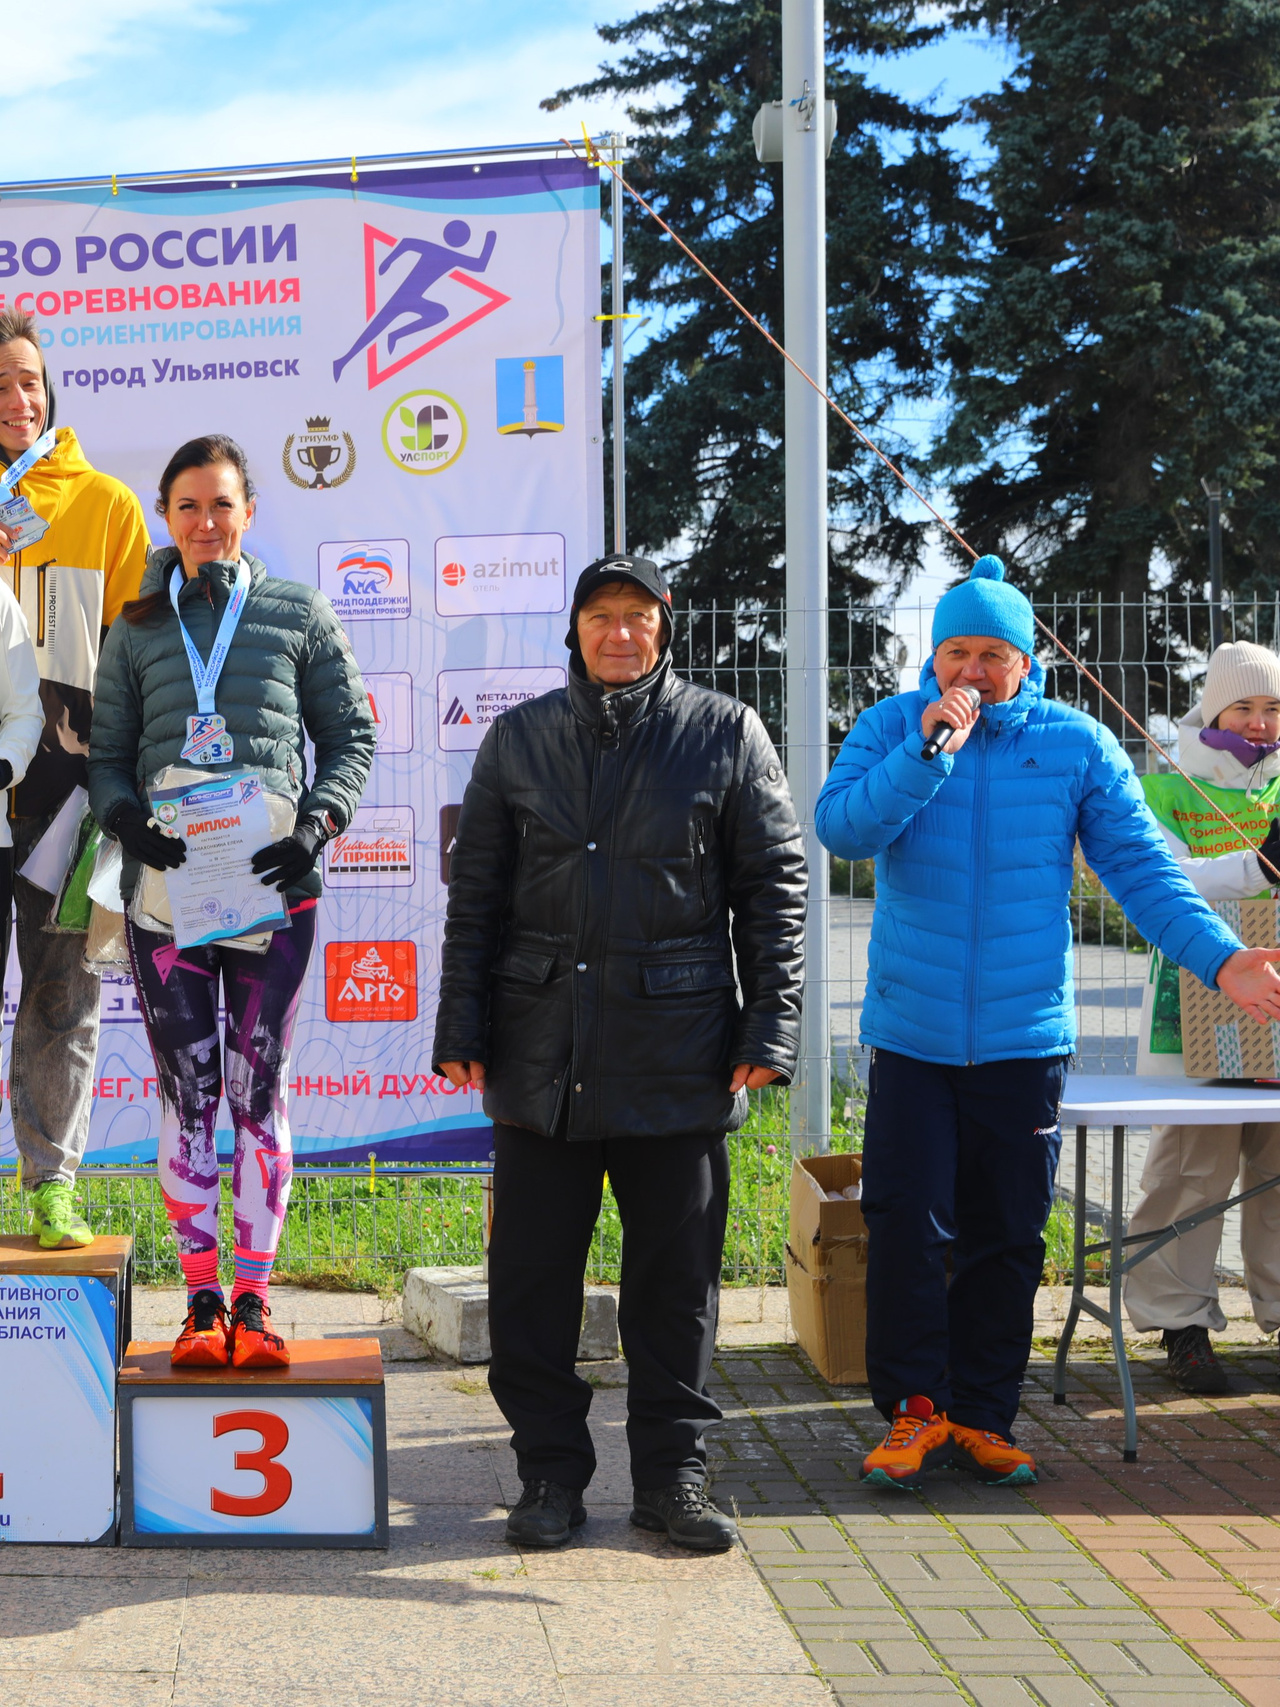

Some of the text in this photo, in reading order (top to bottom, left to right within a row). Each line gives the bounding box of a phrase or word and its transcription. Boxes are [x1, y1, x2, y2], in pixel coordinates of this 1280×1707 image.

[75, 224, 297, 274] РОССИИ
[14, 278, 300, 316] СОРЕВНОВАНИЯ
[61, 316, 302, 347] ОРИЕНТИРОВАНИЯ
[63, 367, 146, 393] город
[152, 358, 300, 383] Ульяновск
[298, 434, 339, 444] ТРИУМФ
[400, 451, 449, 462] УЛСПОРТ
[473, 557, 559, 578] azimut
[331, 596, 408, 607] ОНД ПОДДЕРЖКИ
[205, 642, 222, 687] ВСЕРОССИЙСКИЕ
[210, 646, 226, 688] СОРЕВНОВАНИЯ
[476, 692, 535, 702] МЕТАЛЛО
[212, 744, 222, 757] 3
[188, 790, 231, 802] МИНСПОРТ
[186, 815, 241, 837] ДИПЛОМ
[332, 836, 408, 864] Ульяновский
[343, 852, 408, 863] ПРЯНИК
[338, 977, 405, 1002] АРГО
[210, 1408, 293, 1517] 3
